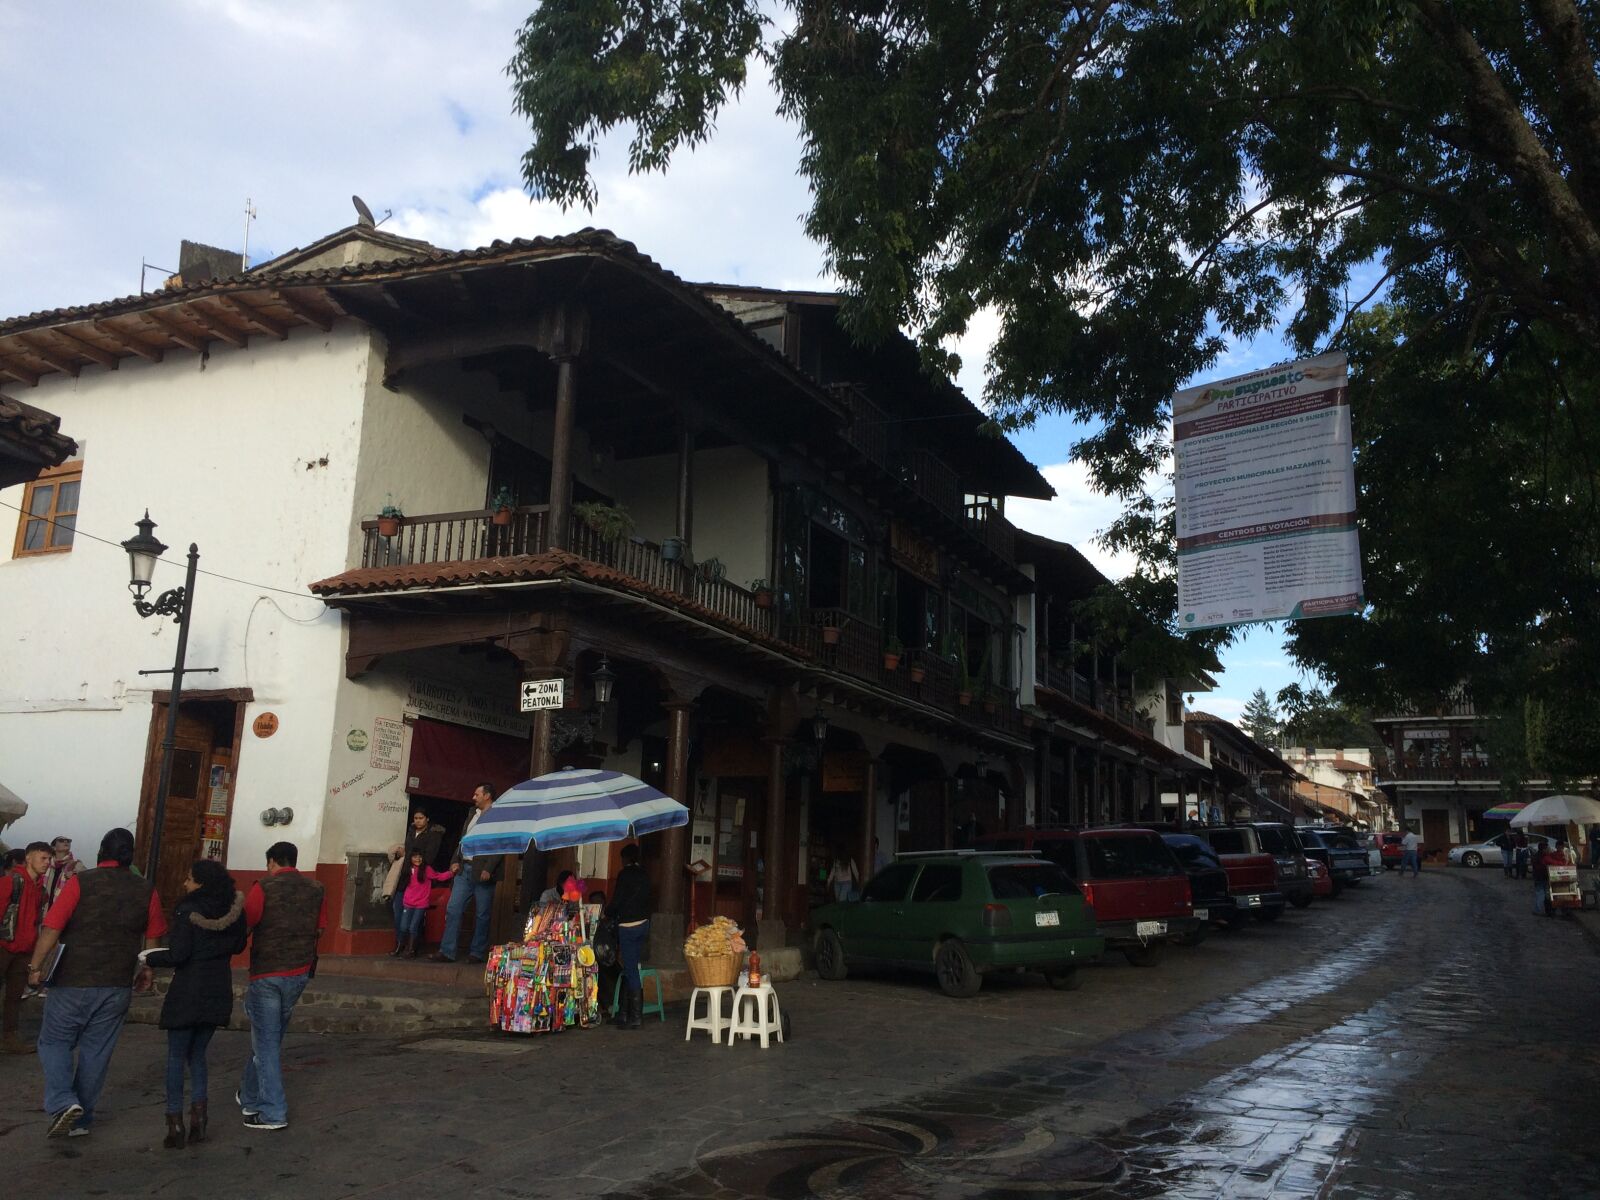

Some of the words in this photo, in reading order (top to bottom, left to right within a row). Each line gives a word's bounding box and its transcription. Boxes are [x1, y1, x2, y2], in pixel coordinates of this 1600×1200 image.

[1217, 386, 1298, 412] PARTICIPATIVO
[1184, 434, 1225, 448] PROYECTOS
[1225, 425, 1271, 440] REGIONALES
[1195, 475, 1236, 489] PROYECTOS
[1236, 467, 1285, 482] MUNICIPALES
[1286, 457, 1332, 472] MAZAMITLA
[1218, 527, 1255, 539] CENTROS
[1256, 524, 1267, 534] DE
[1268, 517, 1311, 531] VOTACIÓN
[538, 683, 559, 694] ZONA
[522, 696, 562, 708] PEATONAL
